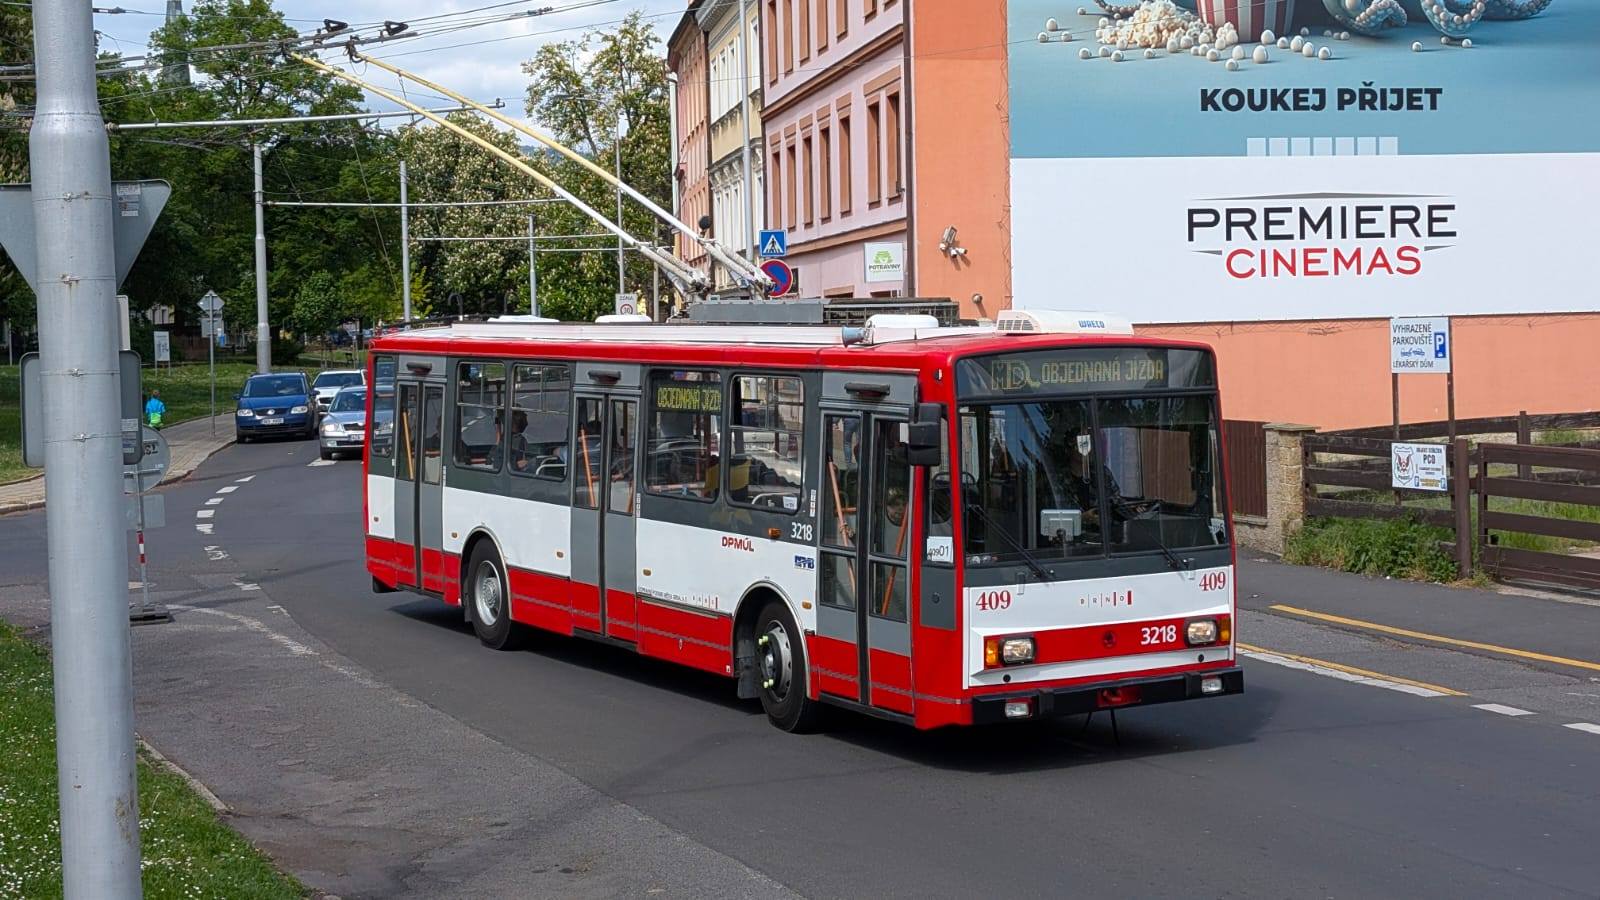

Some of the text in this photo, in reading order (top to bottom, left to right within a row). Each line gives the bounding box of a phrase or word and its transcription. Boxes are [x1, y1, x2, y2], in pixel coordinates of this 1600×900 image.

[1200, 81, 1443, 112] KOUKEJ PŘIJET
[1187, 204, 1457, 242] PREMIERE
[1226, 245, 1422, 279] CINEMAS
[1392, 322, 1432, 333] VYHRAZENÉ
[1392, 333, 1433, 345] PARKOVIŠTĚ
[1041, 355, 1121, 384] OBJEDNANÁ
[1125, 356, 1164, 381] JÍZDA
[1392, 358, 1434, 369] LÉKAŘSKÝ DŮM
[790, 521, 813, 541] 3218
[721, 536, 755, 552] DPMÚL
[1199, 571, 1227, 592] 409
[975, 590, 1011, 611] 409
[1140, 625, 1177, 645] 3218
